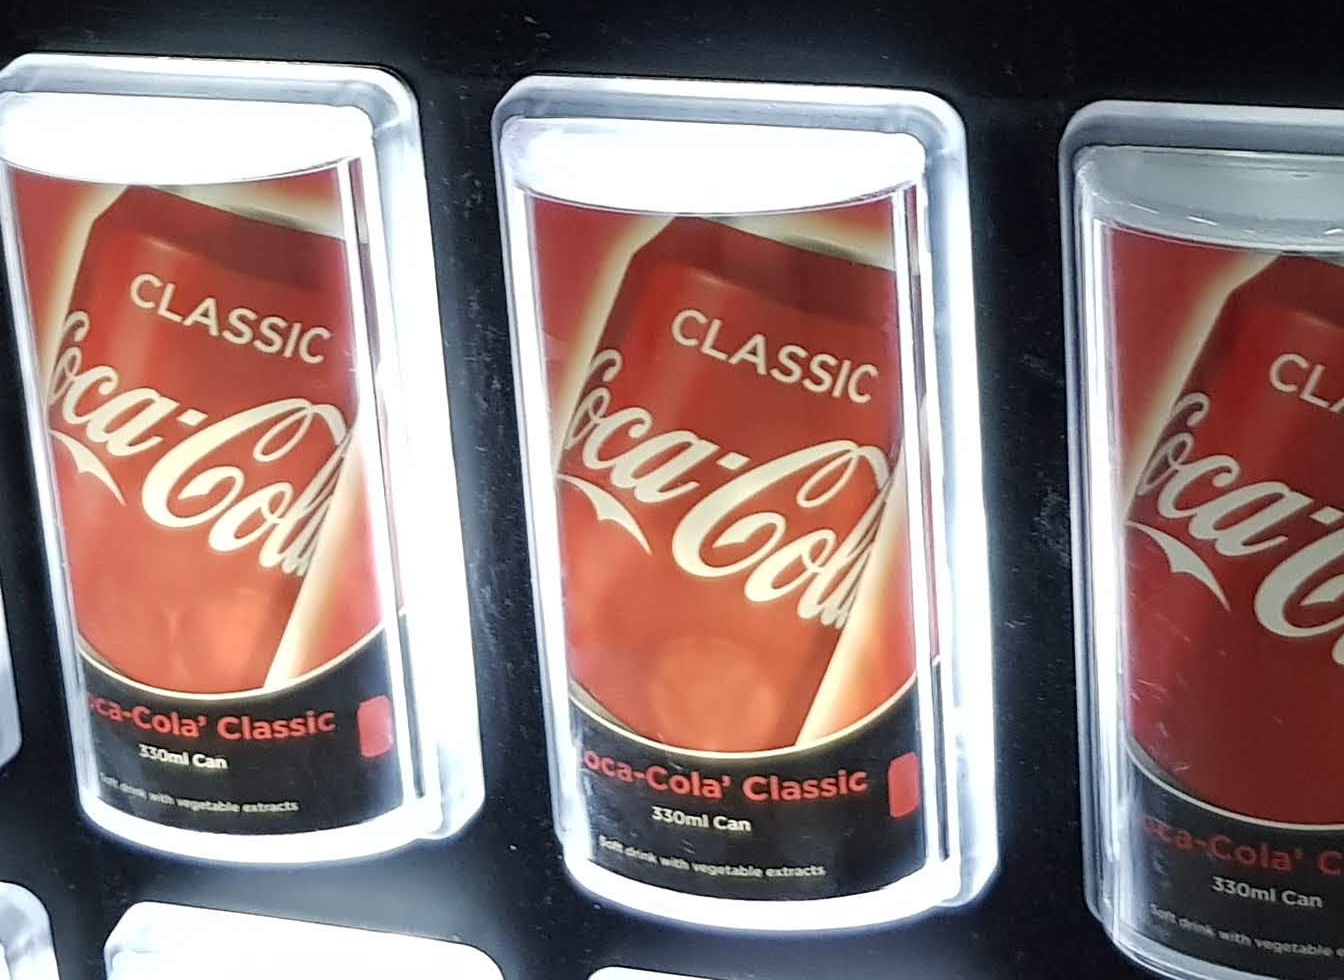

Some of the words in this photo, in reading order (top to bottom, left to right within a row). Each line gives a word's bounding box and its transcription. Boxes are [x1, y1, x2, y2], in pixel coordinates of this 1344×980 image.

[129, 272, 332, 365] CLASSIC
[670, 308, 880, 404] CLASSIC
[216, 709, 337, 742] Classic
[138, 742, 190, 767] 330ml
[191, 753, 230, 770] Can
[741, 767, 870, 803] Classic
[148, 791, 176, 806] with
[176, 798, 241, 812] vegetable
[242, 800, 300, 813] extracts
[651, 805, 710, 829] 330ml
[713, 815, 753, 833] Can
[598, 834, 625, 854] Soft
[624, 845, 658, 865] drink
[659, 855, 691, 871] with
[691, 862, 764, 878] vegetable
[765, 865, 827, 878] extracts
[1211, 875, 1277, 903] 330ml
[1281, 889, 1324, 909] Can
[1217, 929, 1253, 947] with
[1254, 937, 1335, 957] vegetable
